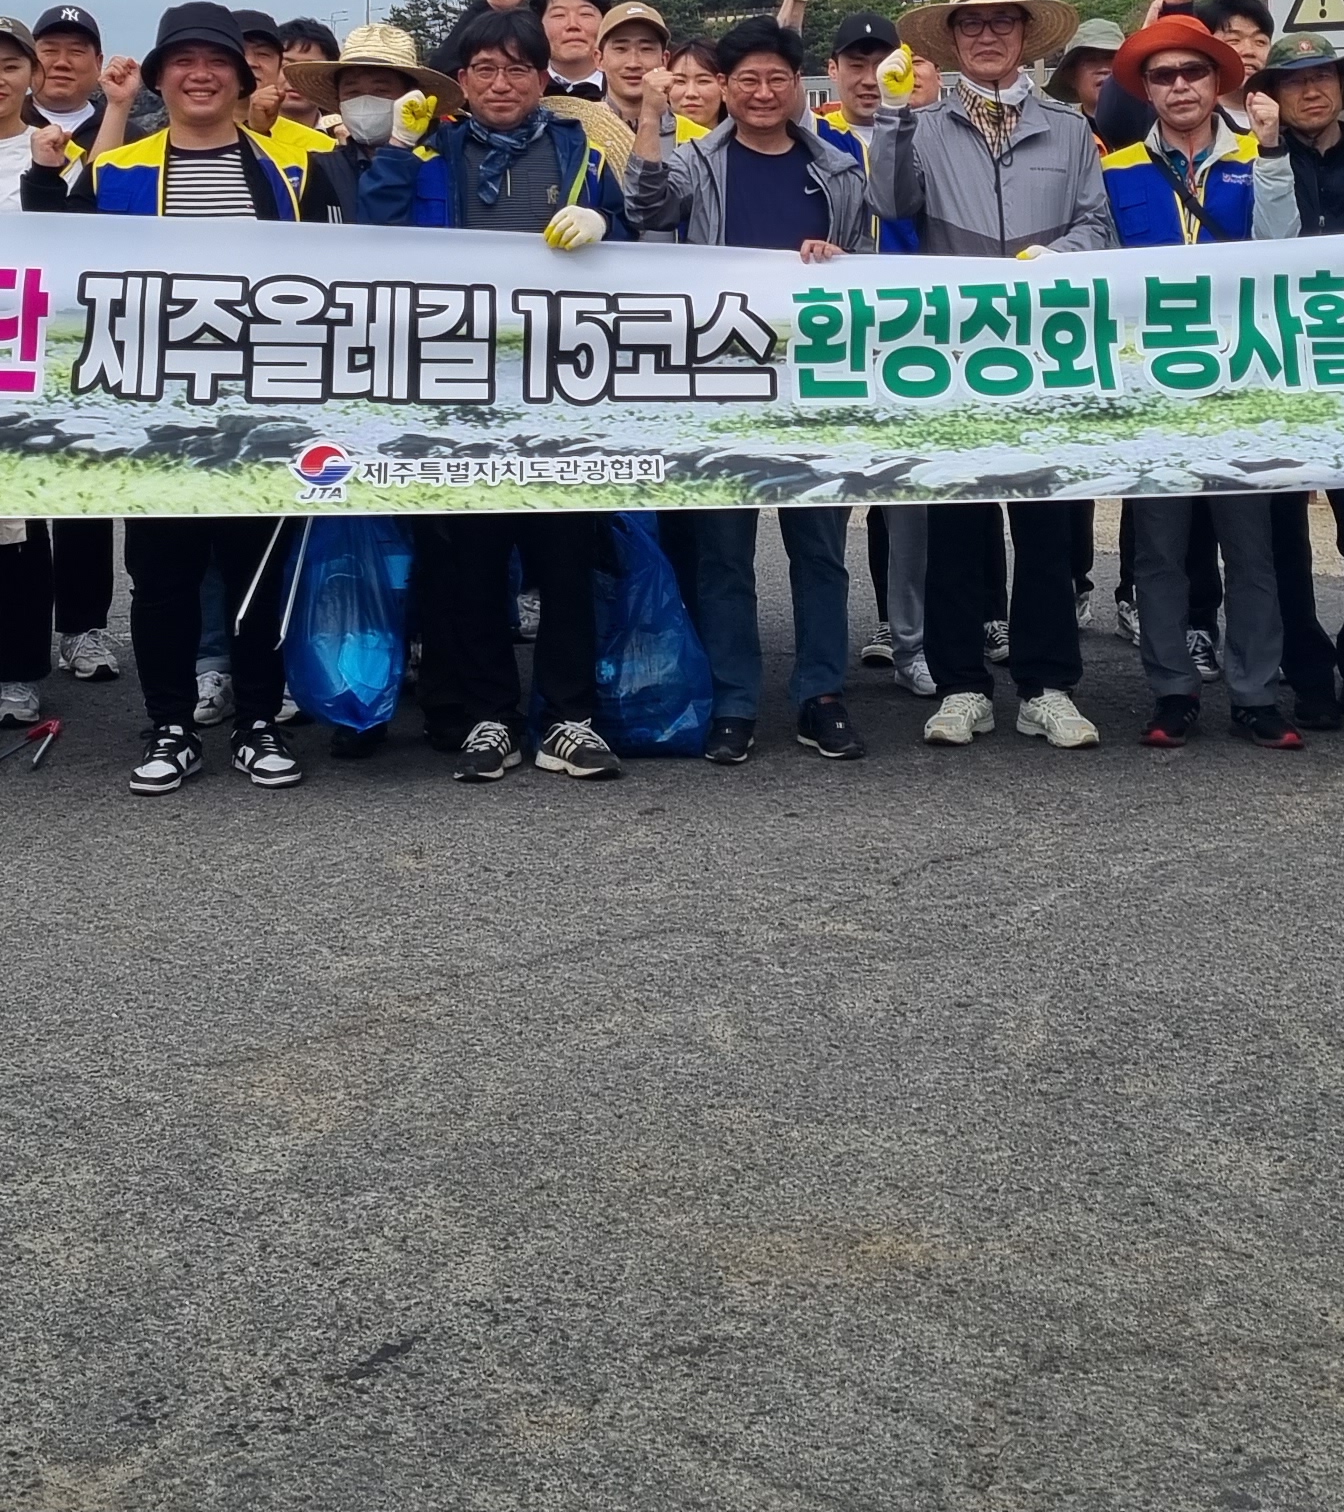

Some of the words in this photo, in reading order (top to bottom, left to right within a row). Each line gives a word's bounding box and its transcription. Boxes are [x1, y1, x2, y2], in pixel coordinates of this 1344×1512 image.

[72, 271, 496, 405] 제주올레길
[513, 289, 778, 406] 15코스
[792, 277, 1117, 399] 환경정화
[362, 458, 662, 485] 제주특별자치도관광협회
[299, 487, 344, 500] JTA
